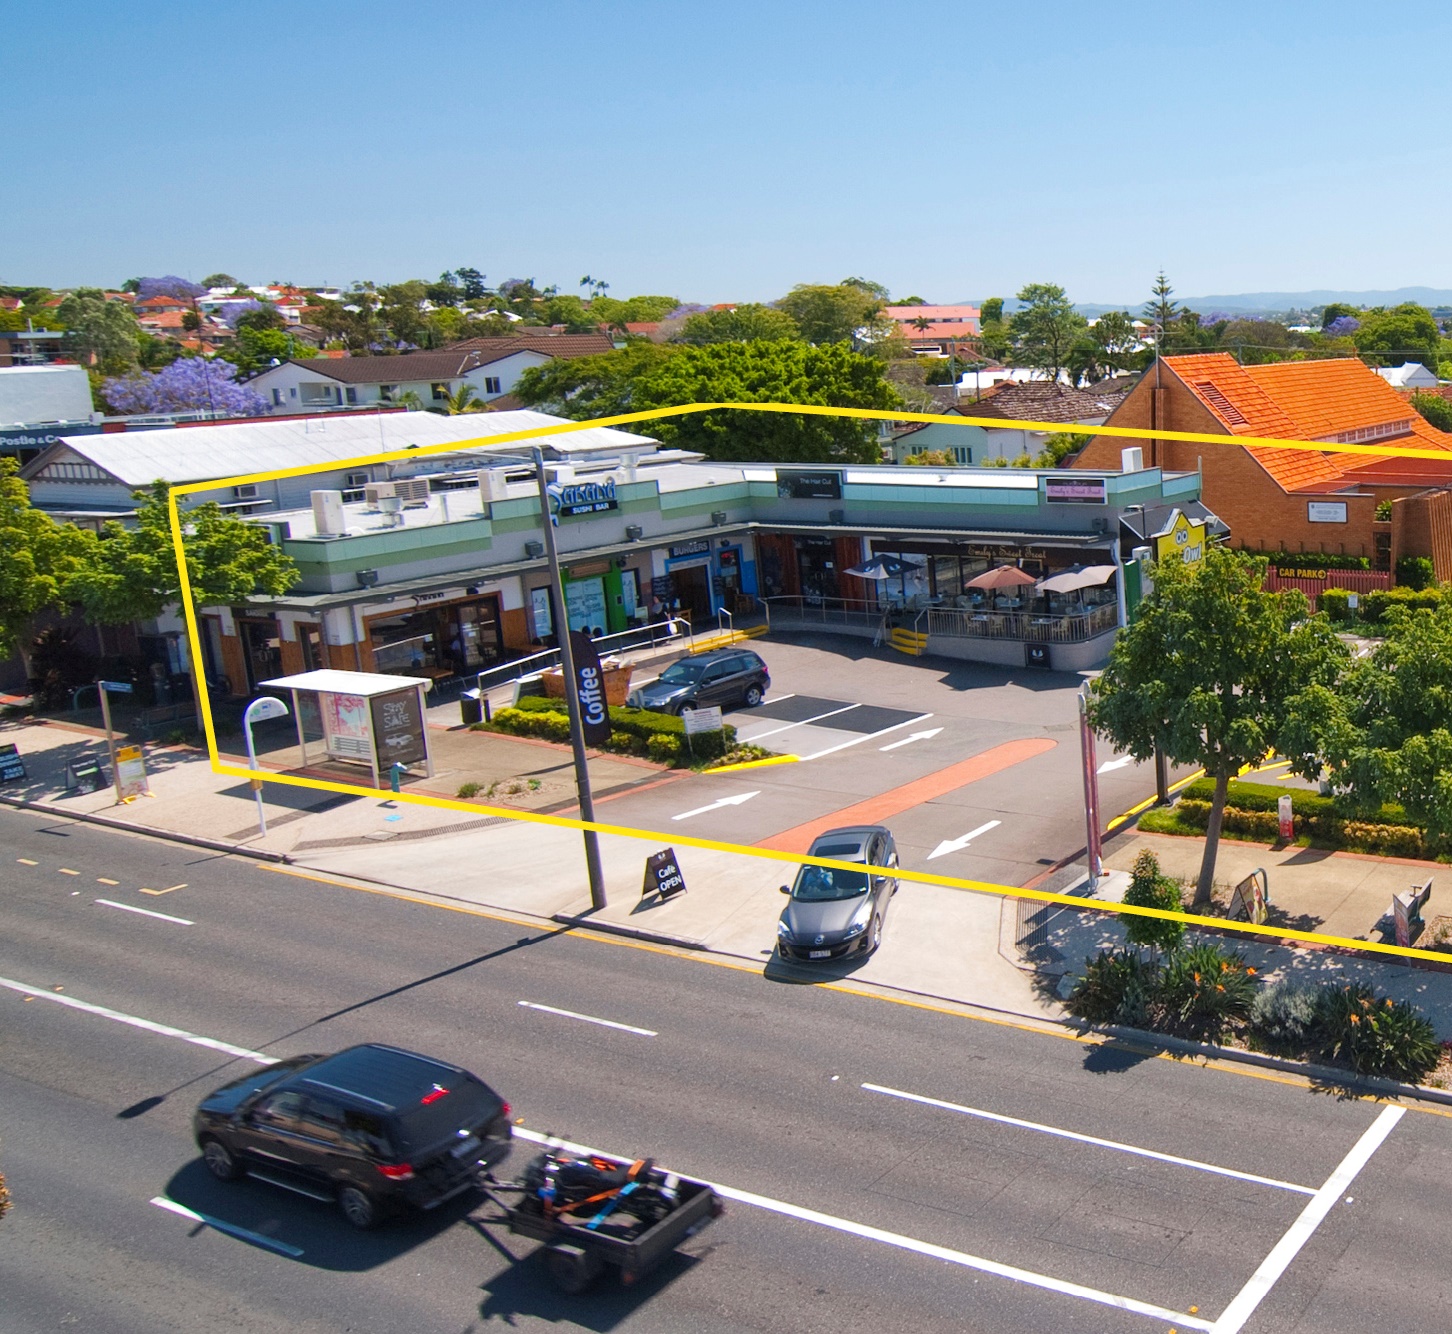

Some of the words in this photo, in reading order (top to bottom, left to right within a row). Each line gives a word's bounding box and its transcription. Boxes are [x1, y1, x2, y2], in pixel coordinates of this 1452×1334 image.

[0, 434, 36, 446] Postle
[573, 504, 593, 514] SUSHI
[595, 501, 609, 511] BAR
[673, 542, 708, 556] BURGERS
[1279, 568, 1295, 577] CAR
[1296, 569, 1318, 578] PARK
[579, 666, 606, 725] Coffee
[660, 874, 683, 892] OPEN
